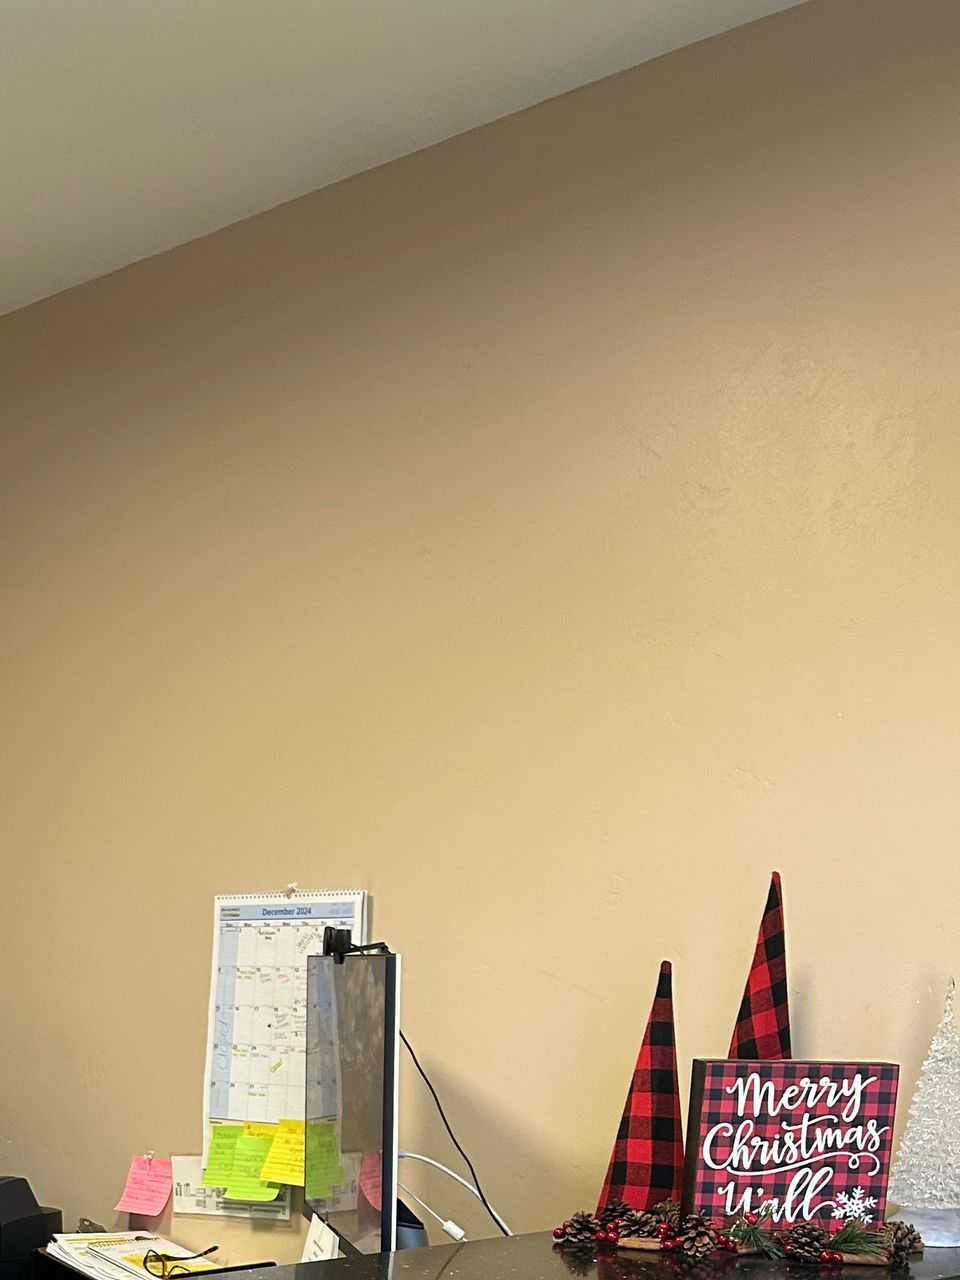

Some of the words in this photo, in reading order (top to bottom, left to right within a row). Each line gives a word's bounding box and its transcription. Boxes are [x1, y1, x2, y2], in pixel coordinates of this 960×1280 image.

[262, 907, 295, 916] December
[296, 907, 312, 915] 2024
[726, 1072, 877, 1122] Merry
[702, 1113, 890, 1170] Christmas
